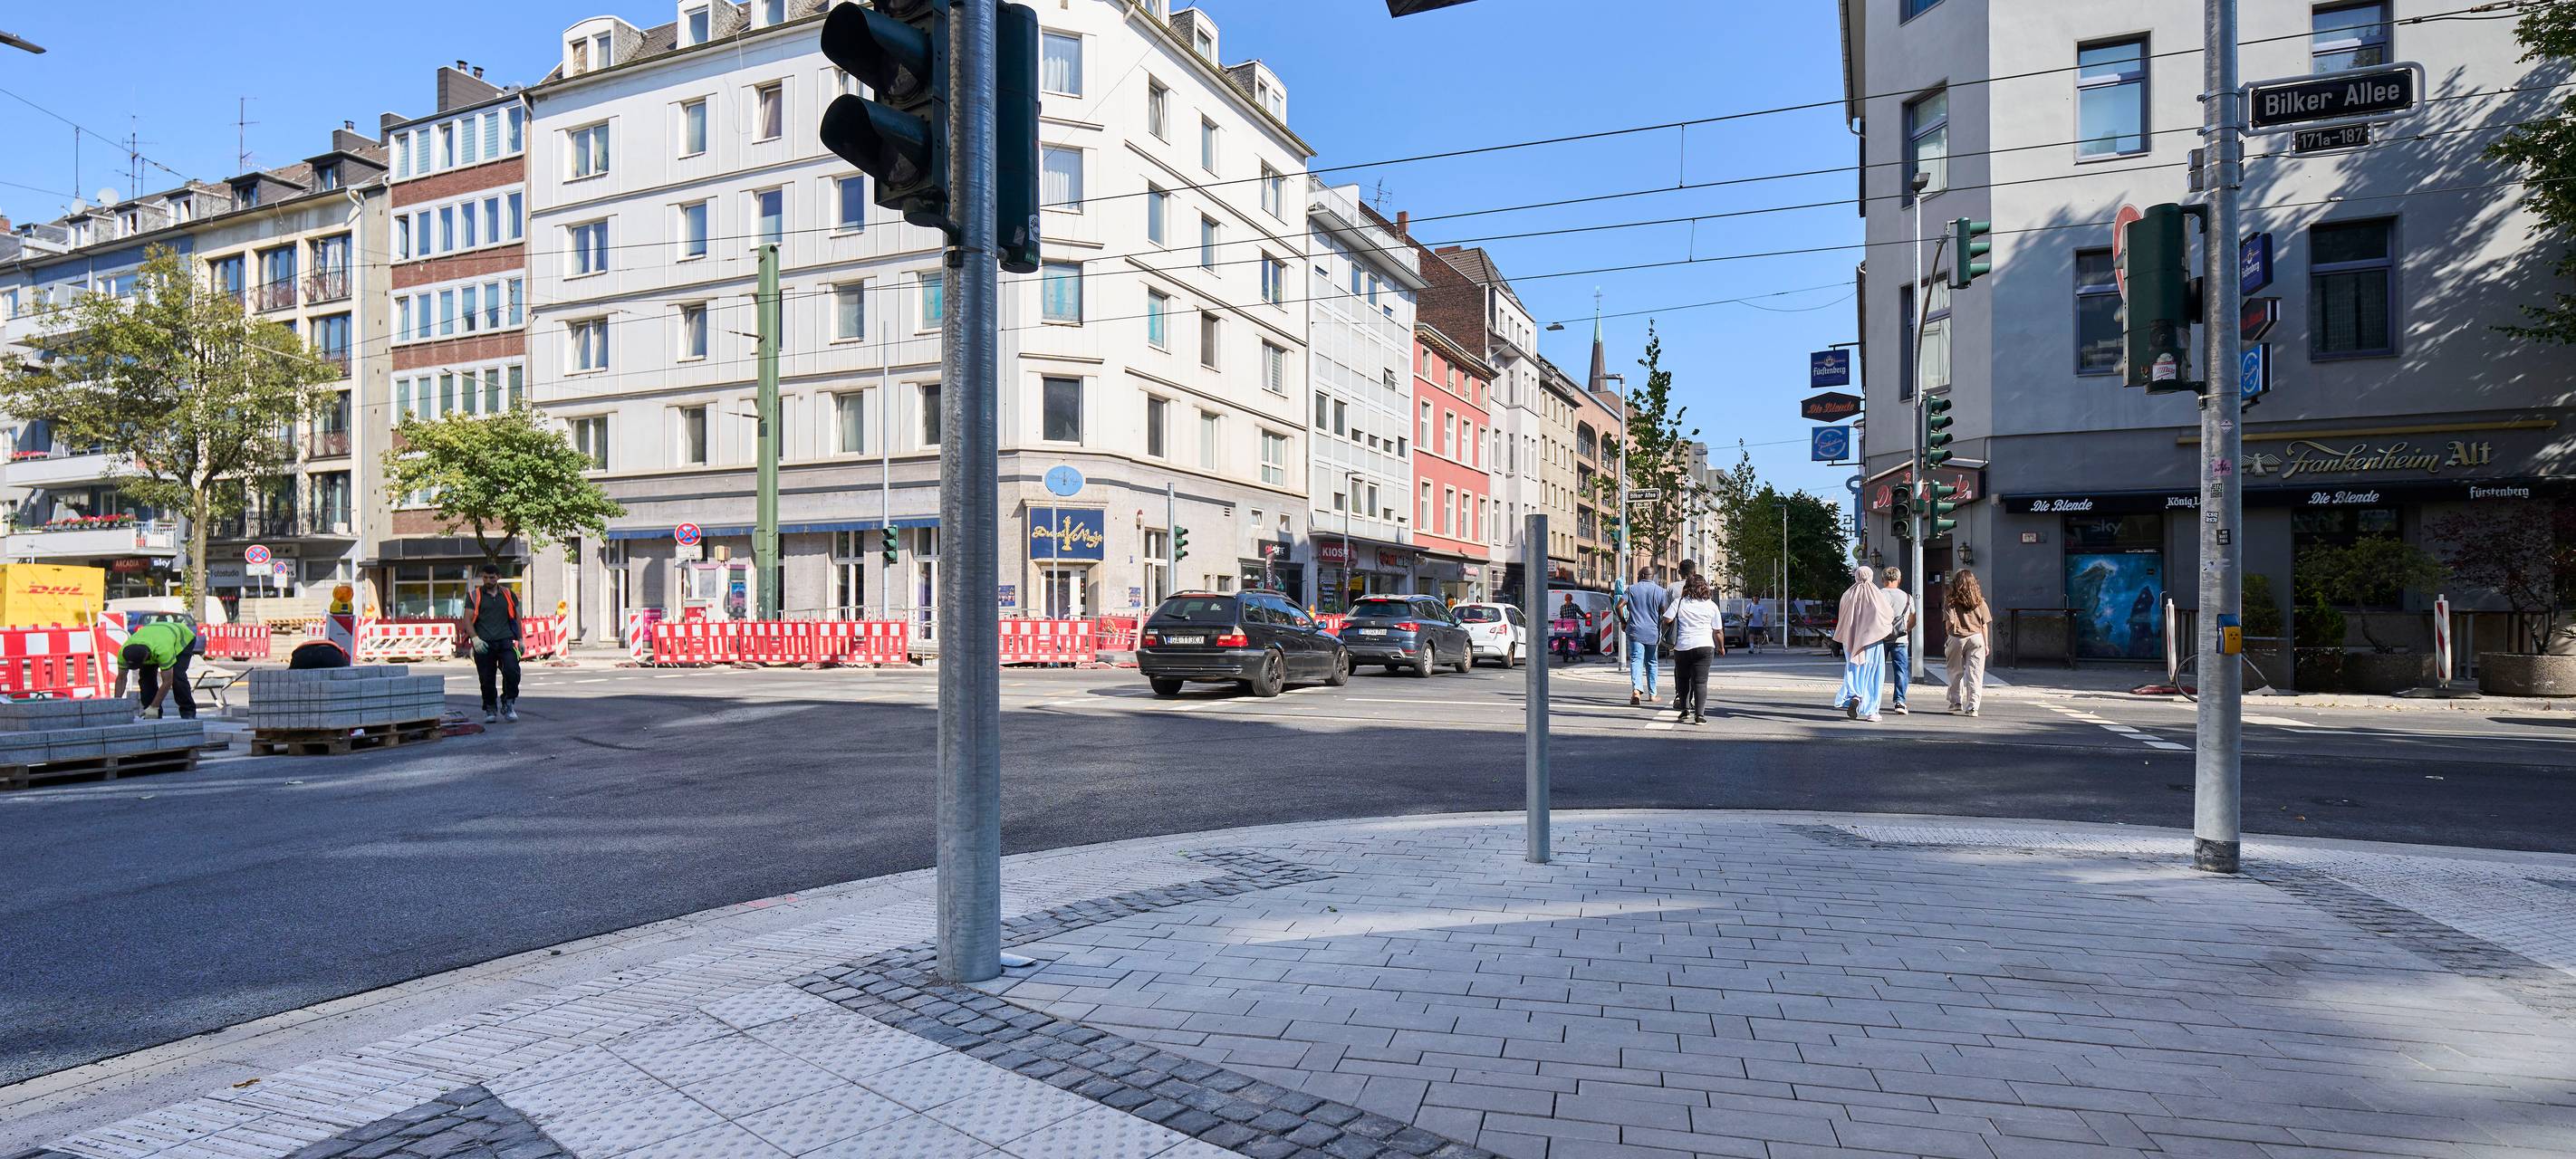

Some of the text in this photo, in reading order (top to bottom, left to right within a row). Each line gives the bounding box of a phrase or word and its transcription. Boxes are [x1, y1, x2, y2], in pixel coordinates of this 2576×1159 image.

[2265, 81, 2399, 116] Bilker Allee
[2300, 128, 2364, 148] 171a-187
[1813, 367, 1846, 377] Fürstenberg
[2282, 440, 2493, 479] Frankenheim Alt
[2308, 490, 2380, 504] Die Blende
[2469, 485, 2530, 499] Fürstenberg
[2031, 498, 2093, 512] Die Blende
[2165, 497, 2193, 509] König
[2091, 519, 2122, 535] sky
[153, 558, 171, 569] sky
[29, 585, 84, 595] DHL
